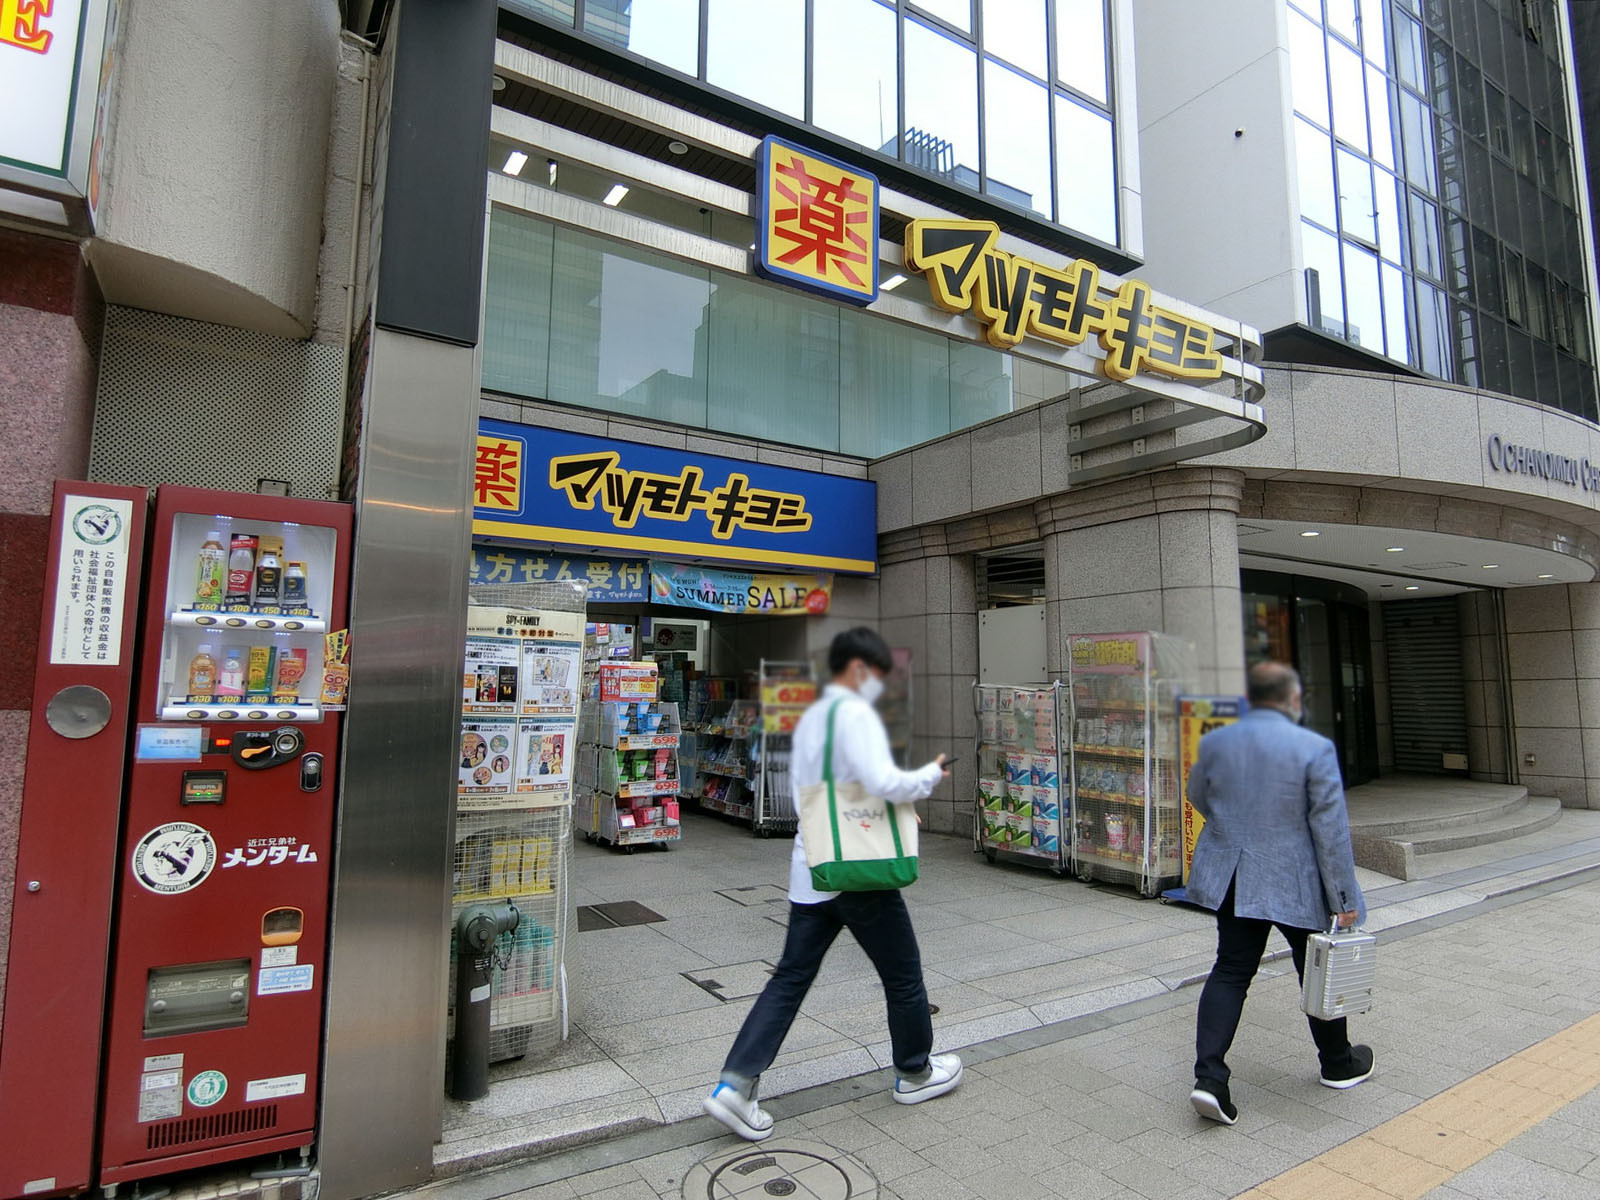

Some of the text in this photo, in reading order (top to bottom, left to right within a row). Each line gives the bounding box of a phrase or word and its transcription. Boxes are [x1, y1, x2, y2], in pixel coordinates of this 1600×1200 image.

[775, 156, 867, 287] 薬
[918, 227, 1219, 372] マツモトキヨシ
[475, 443, 518, 507] 薬
[552, 455, 811, 536] マツモトキヨシ
[70, 549, 85, 604] 用いられます。
[81, 550, 100, 660] 社会福祉団体への寄付として
[96, 551, 115, 660] この自動販売機の収益金は
[676, 586, 746, 607] SUMMER
[747, 586, 807, 609] SALE
[653, 735, 678, 745] 698
[654, 781, 679, 791] 698
[248, 837, 297, 847] 近江兄弟社
[653, 828, 679, 838] 698
[222, 844, 318, 868] メンターム
[154, 881, 191, 892] MENTURM
